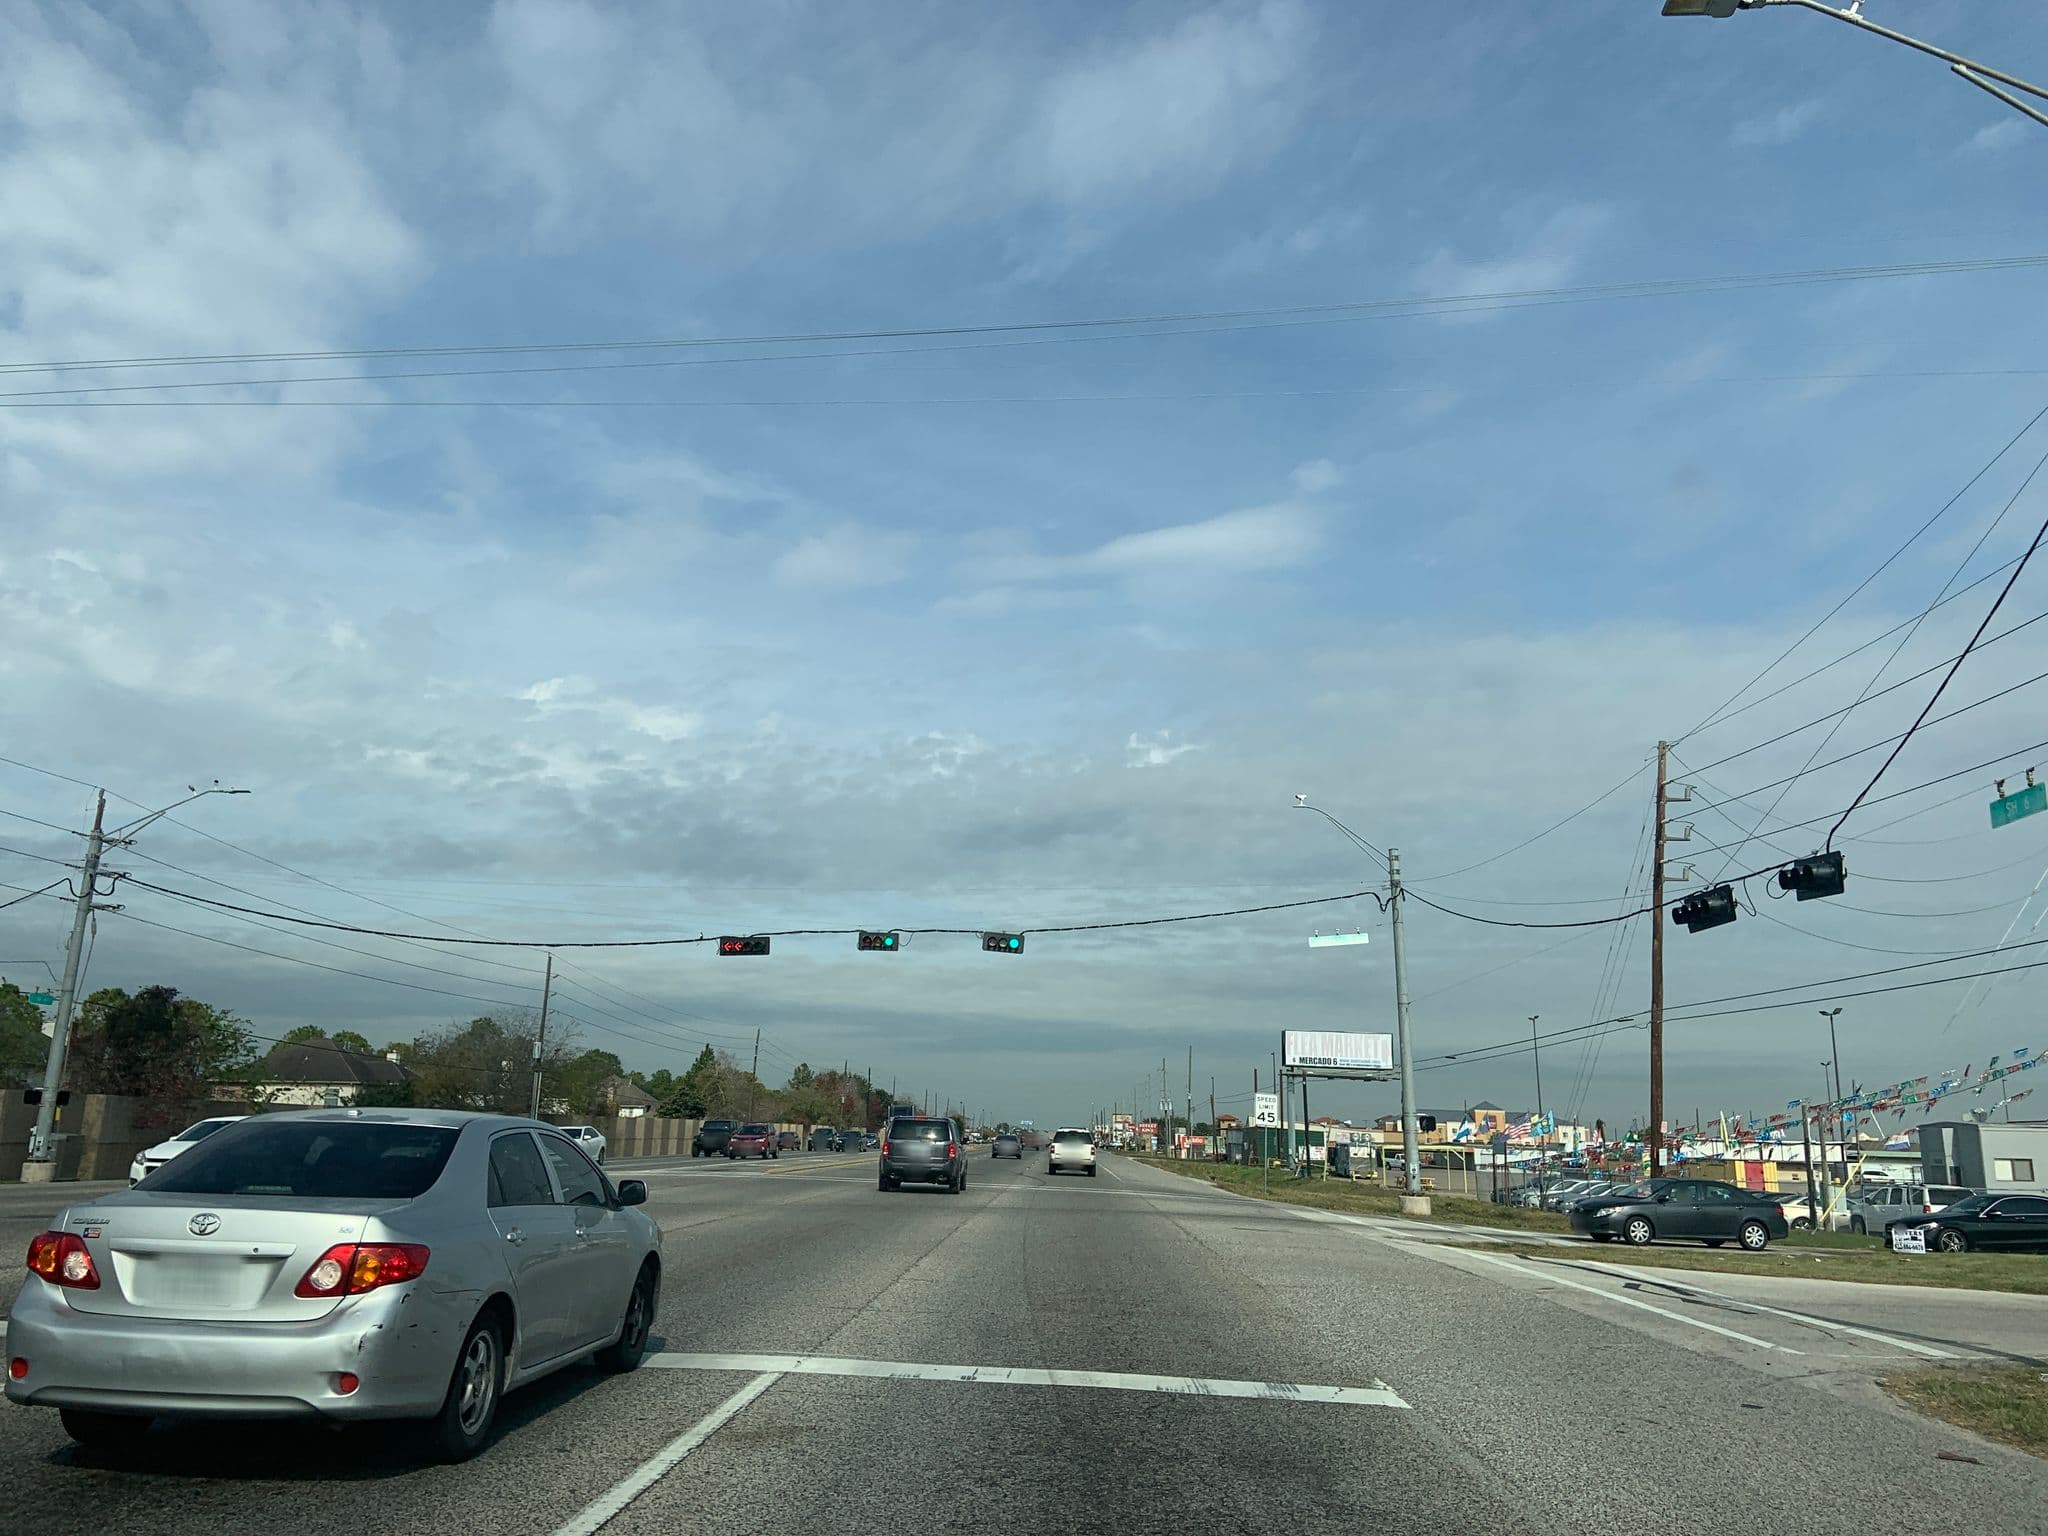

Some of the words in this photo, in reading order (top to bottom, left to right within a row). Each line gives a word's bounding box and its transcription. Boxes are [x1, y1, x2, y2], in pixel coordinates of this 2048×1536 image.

[1299, 1056, 1332, 1066] MERCADO
[1333, 1057, 1338, 1066] 6
[1257, 1111, 1276, 1123] 45
